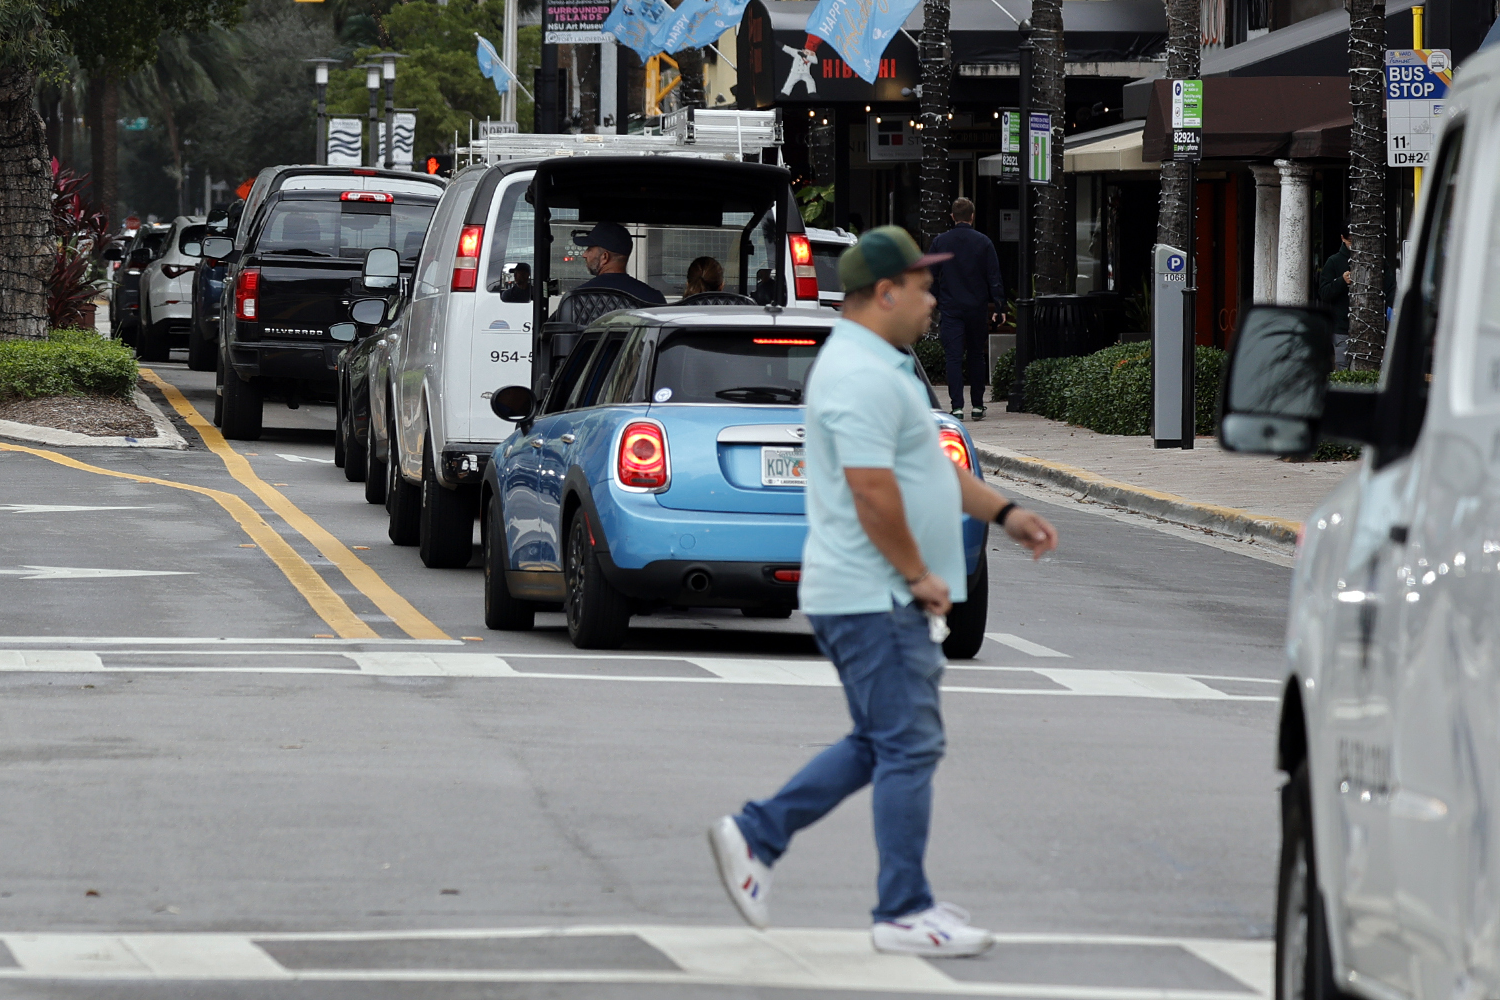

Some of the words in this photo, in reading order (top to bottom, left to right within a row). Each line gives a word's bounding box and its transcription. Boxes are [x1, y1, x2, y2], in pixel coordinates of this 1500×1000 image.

[548, 6, 610, 14] SURROUNDED
[555, 13, 603, 22] ISLANDS
[580, 22, 604, 30] Museu
[665, 14, 690, 48] HAPPY
[822, 58, 896, 79] HIBHI
[1390, 66, 1424, 82] BUS
[1390, 82, 1434, 98] STOP
[1174, 132, 1195, 142] 82921
[1393, 136, 1406, 148] 11
[1002, 156, 1018, 166] 82921
[1394, 153, 1430, 164] ID#24
[1171, 258, 1181, 270] P
[264, 328, 324, 336] SILVERADO
[490, 350, 533, 362] 954-5
[767, 458, 791, 476] KQY
